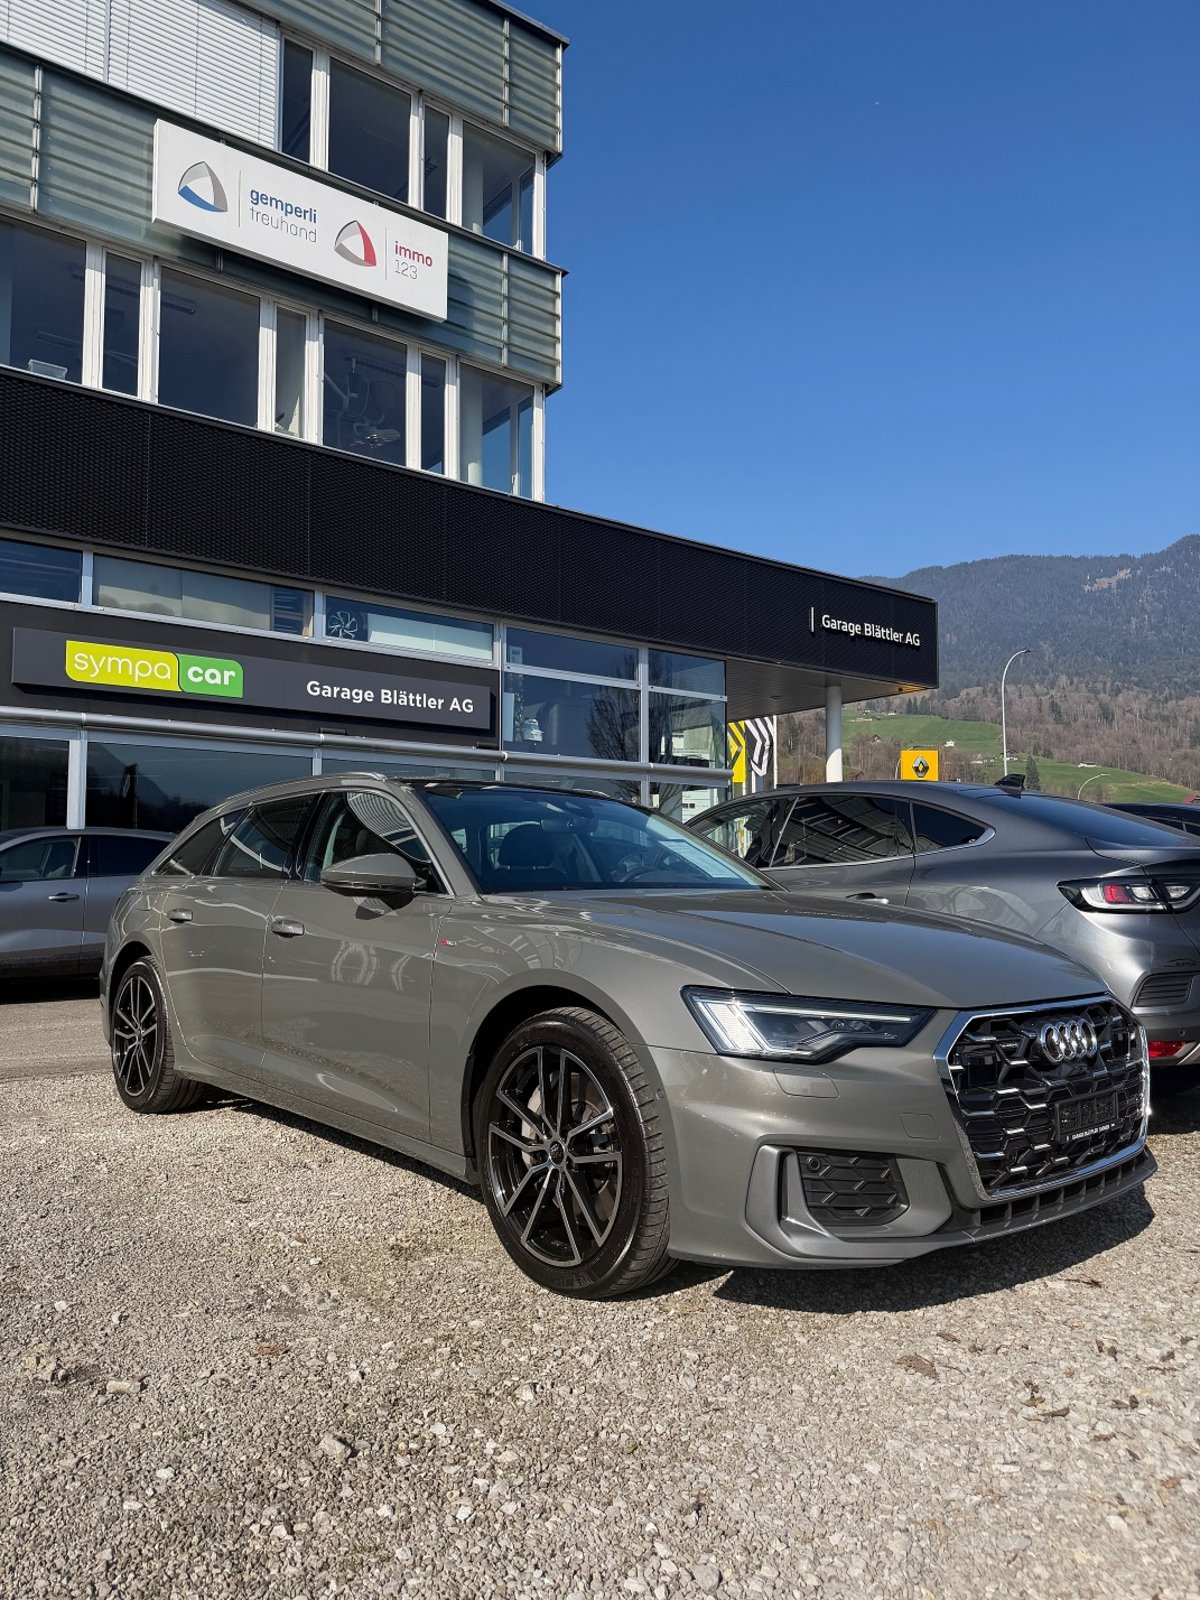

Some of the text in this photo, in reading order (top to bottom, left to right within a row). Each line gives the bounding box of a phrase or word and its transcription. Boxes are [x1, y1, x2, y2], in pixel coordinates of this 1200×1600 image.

[249, 188, 317, 224] gemperli
[249, 206, 317, 244] treuhand
[394, 240, 433, 268] immo
[394, 258, 418, 280] 123
[821, 614, 920, 646] Garage Blättler AG
[73, 652, 236, 686] sympa car
[306, 680, 474, 714] Garage Blättler AG
